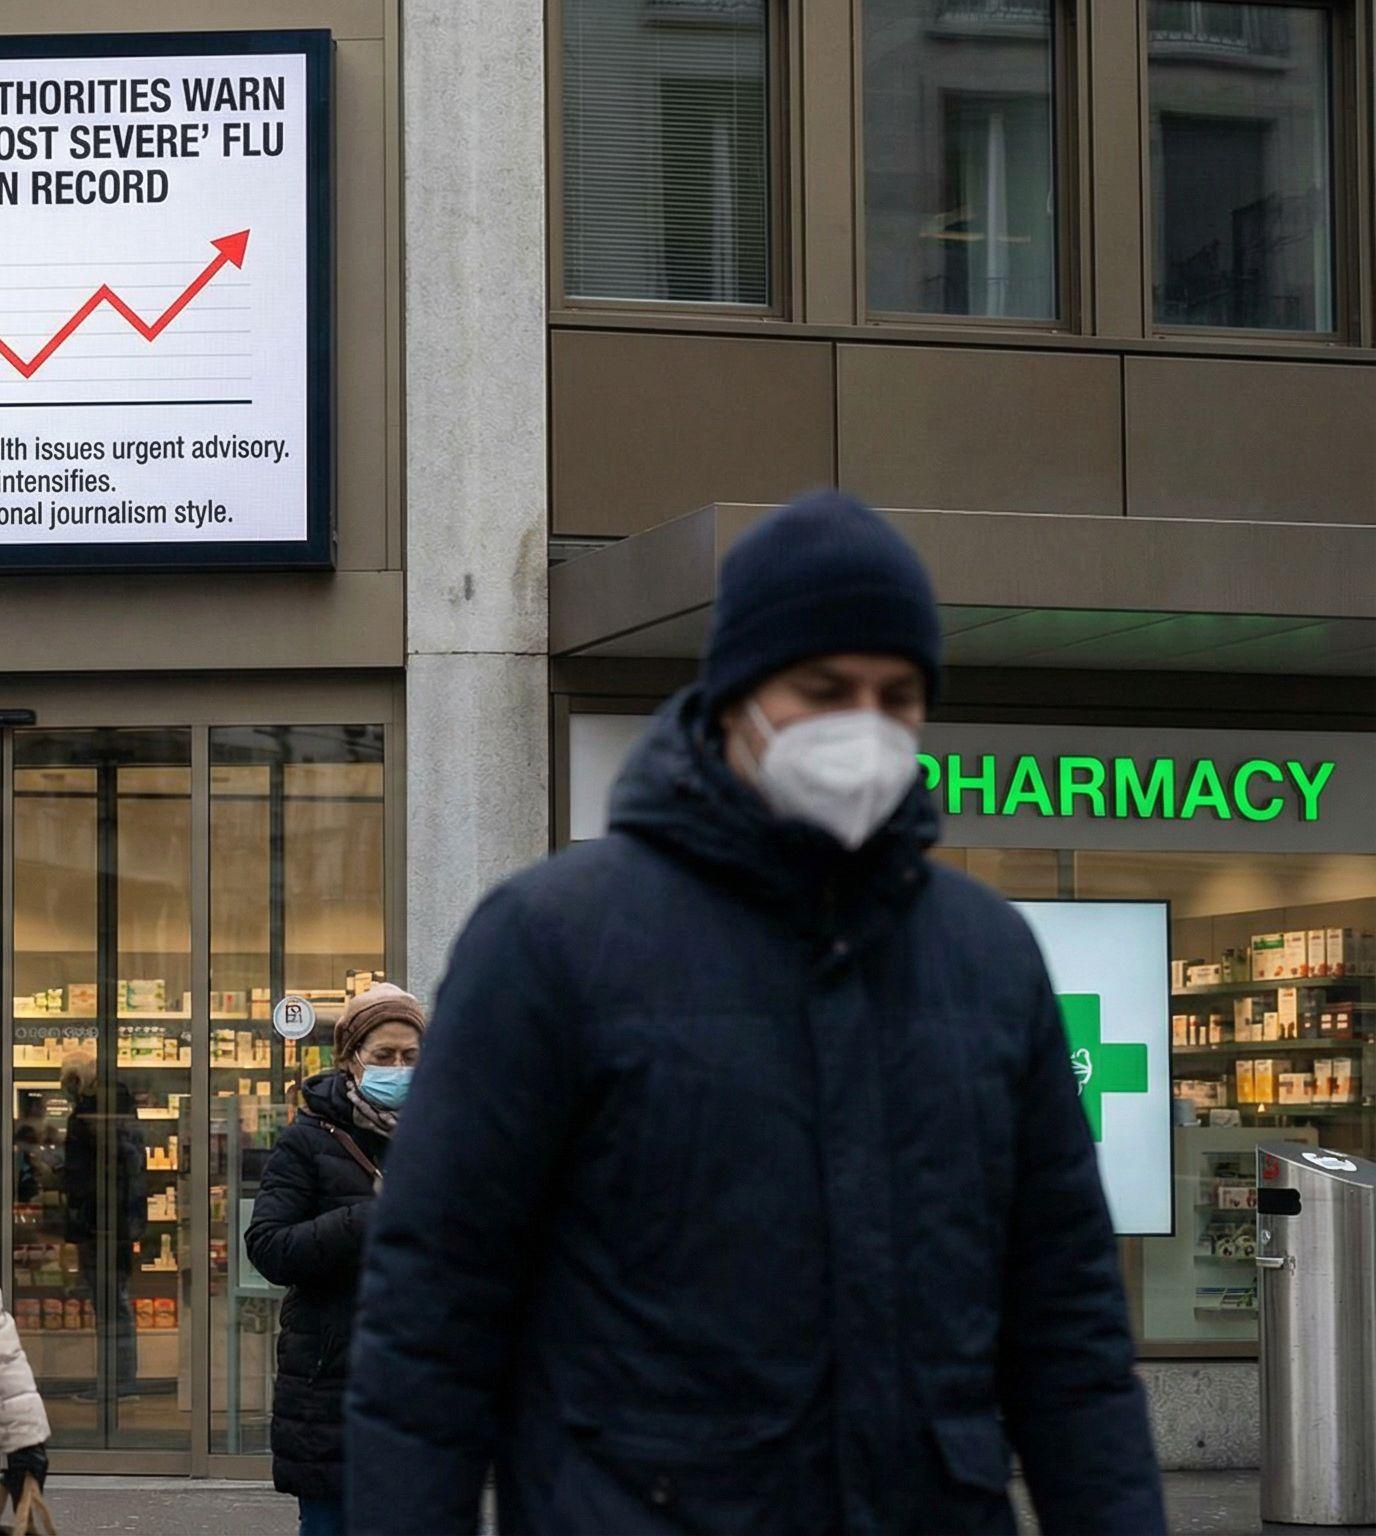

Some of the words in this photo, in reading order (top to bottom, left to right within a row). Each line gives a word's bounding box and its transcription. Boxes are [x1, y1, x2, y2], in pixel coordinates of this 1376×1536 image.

[182, 76, 285, 112] WARN
[223, 121, 284, 157] FLU
[31, 169, 169, 205] RECORD
[35, 436, 105, 461] issues
[112, 435, 185, 465] urgent
[191, 434, 290, 464] advisory.
[48, 500, 167, 531] journalism
[174, 499, 233, 529] style.
